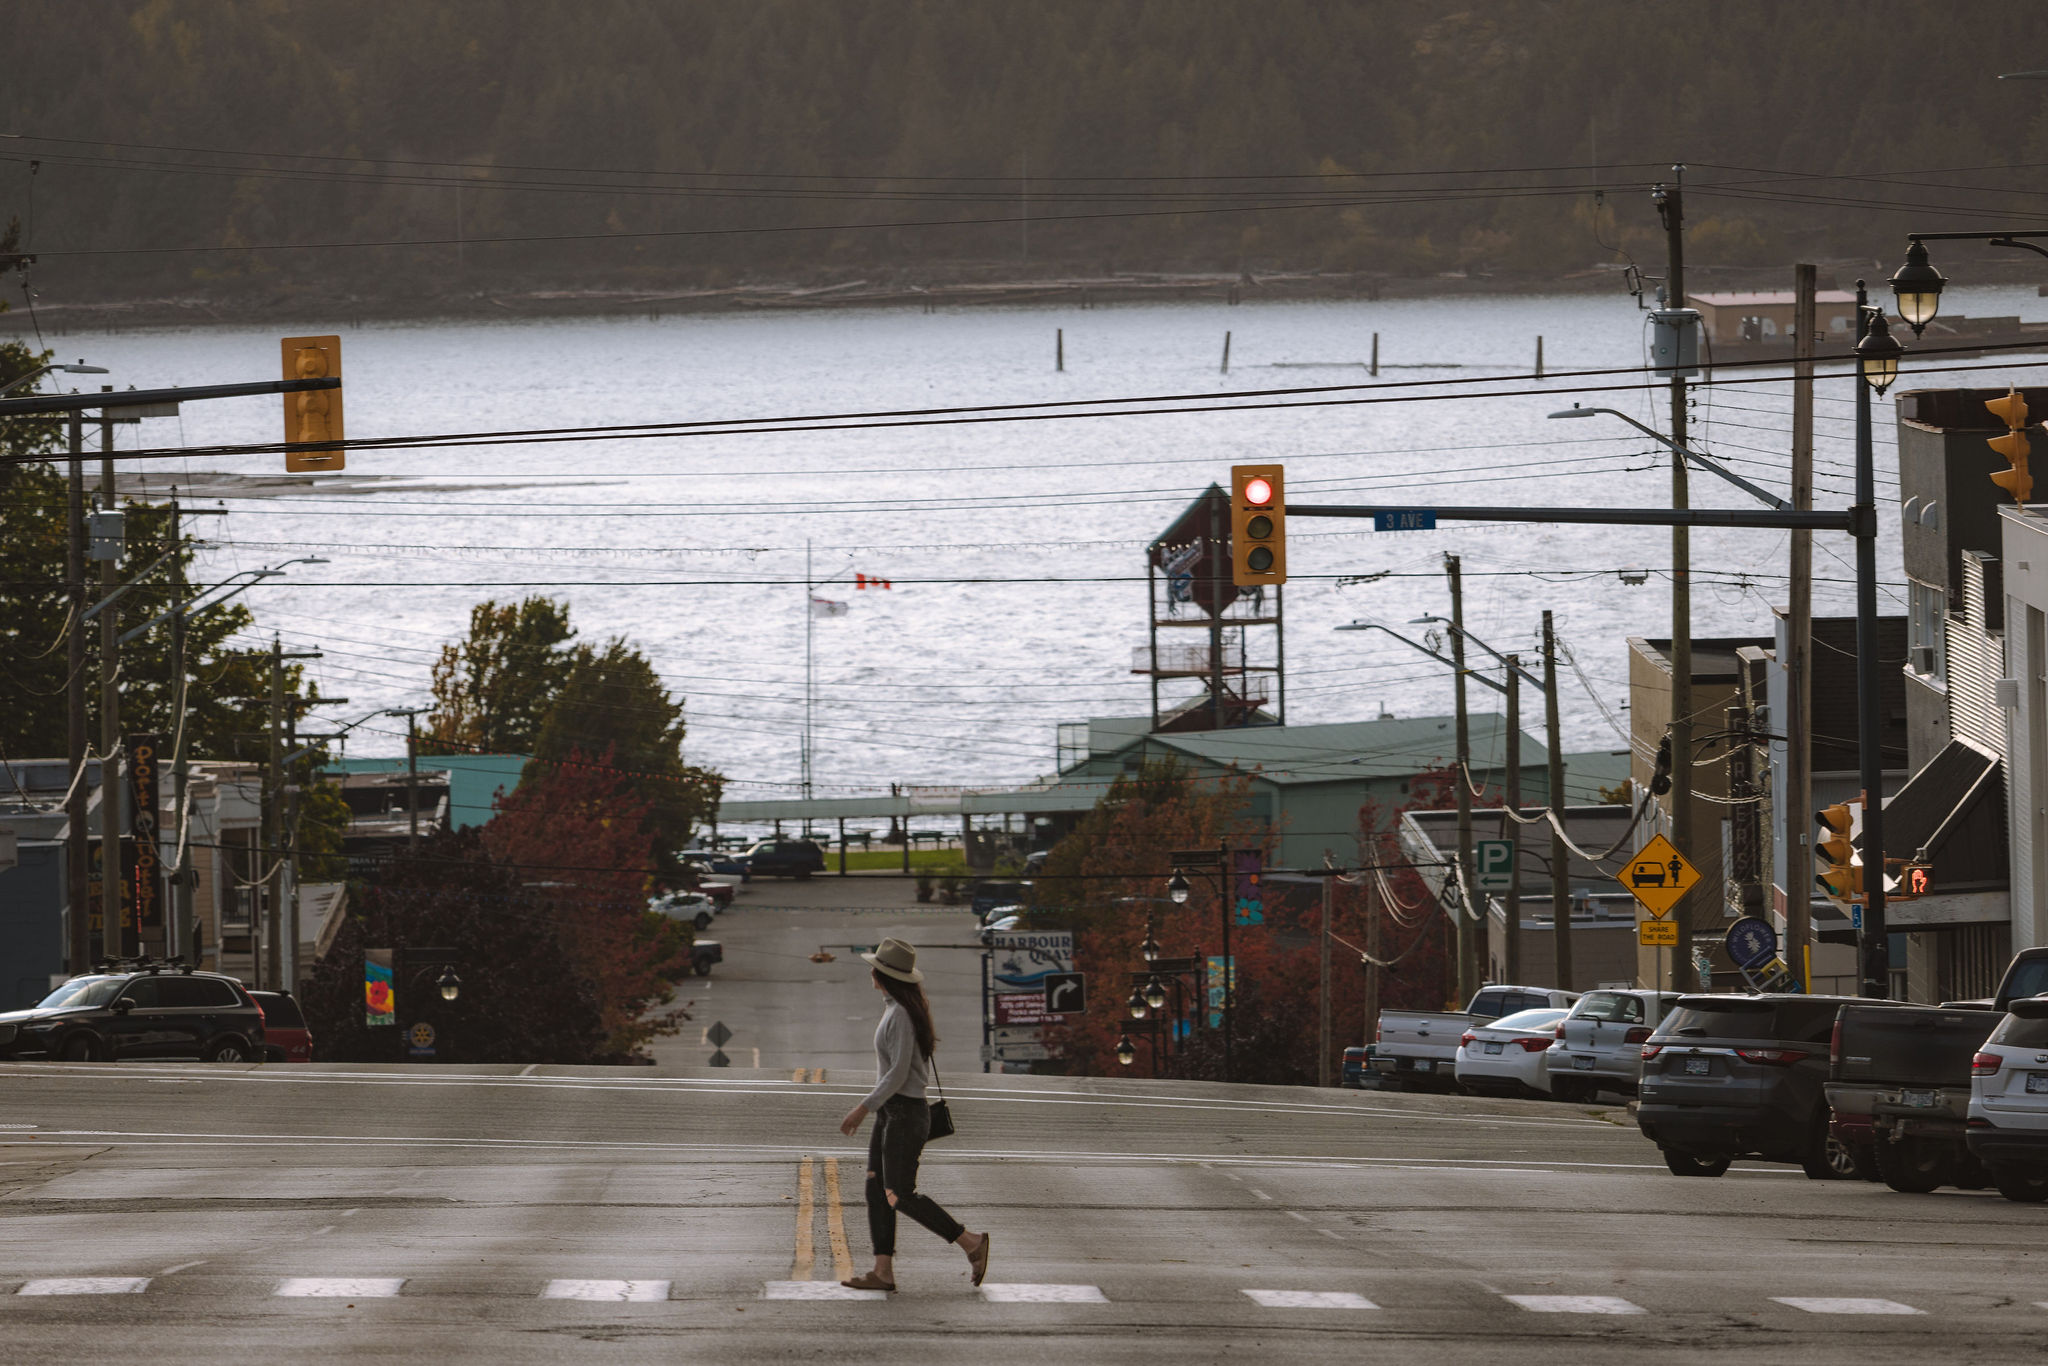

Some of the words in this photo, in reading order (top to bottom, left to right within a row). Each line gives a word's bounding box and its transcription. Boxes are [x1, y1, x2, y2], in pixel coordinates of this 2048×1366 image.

[1386, 513, 1394, 528] 3
[1400, 513, 1424, 528] AVE
[1483, 843, 1508, 872] P
[995, 936, 1071, 948] HARBOUR
